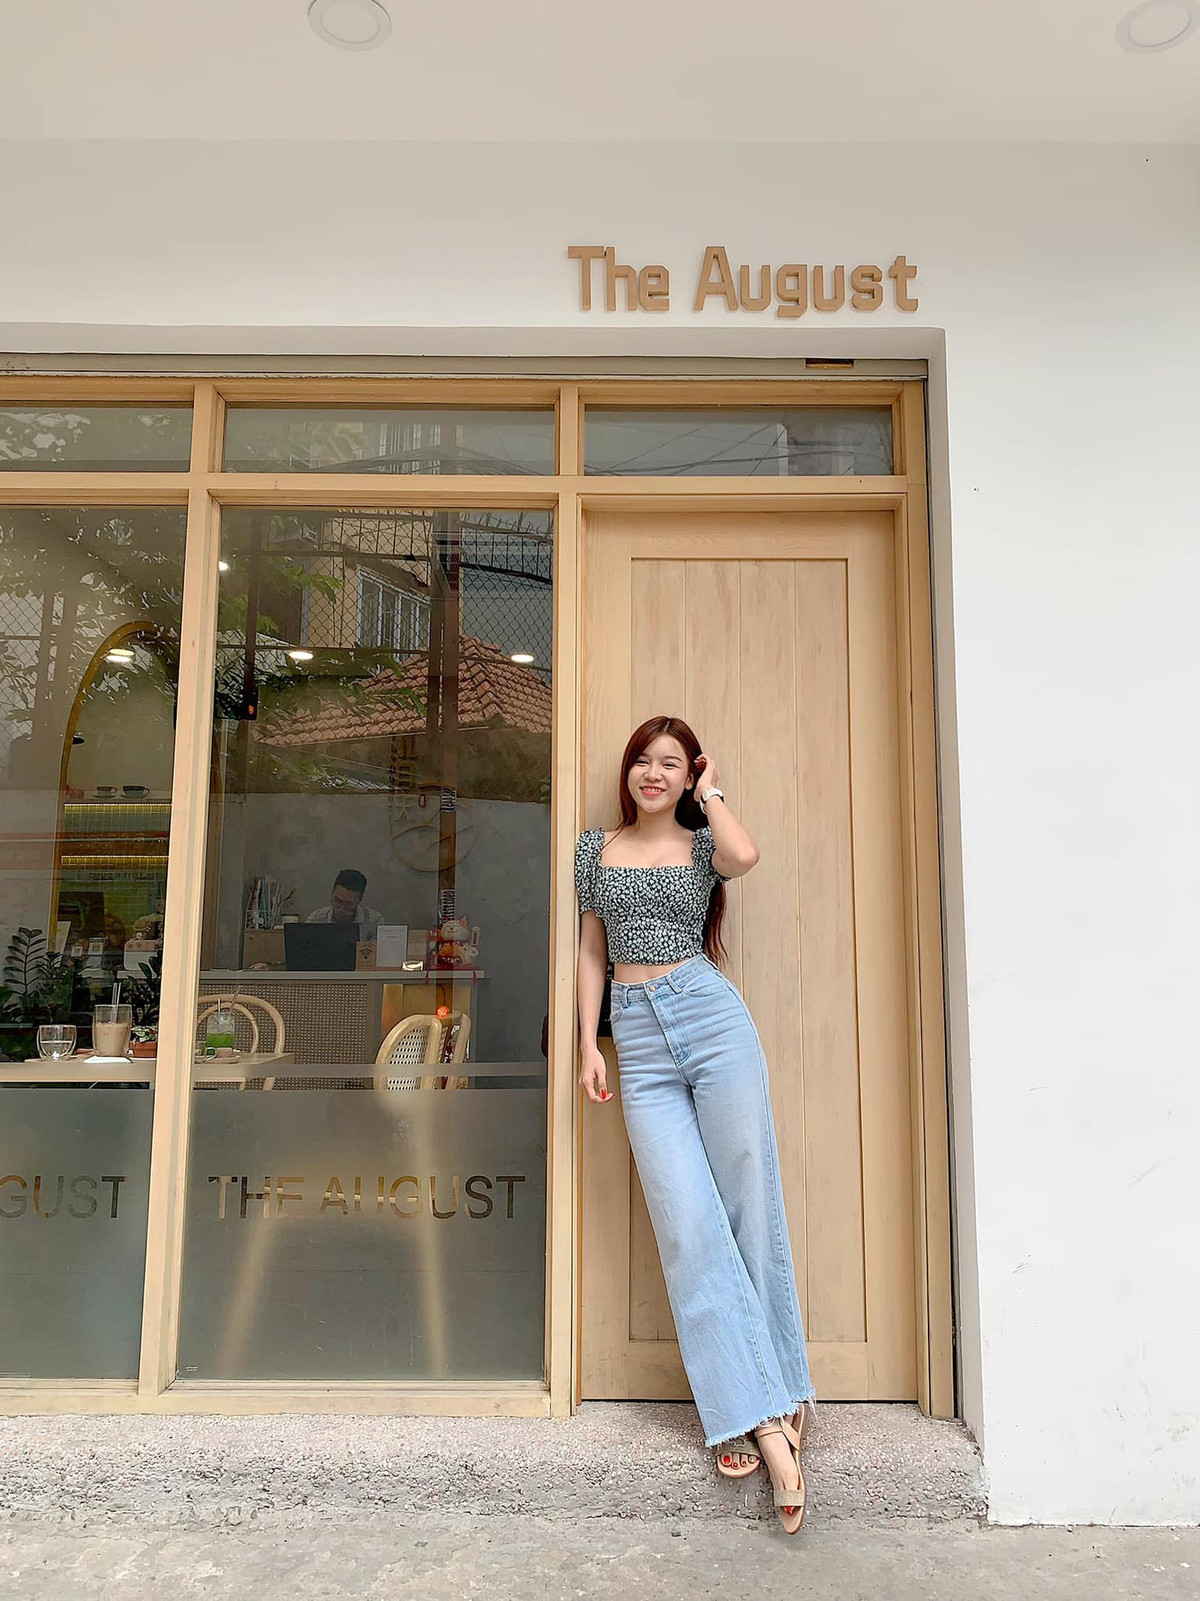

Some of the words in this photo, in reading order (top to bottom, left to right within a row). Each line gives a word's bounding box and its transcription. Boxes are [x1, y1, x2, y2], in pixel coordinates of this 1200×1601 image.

[567, 245, 670, 312] The
[693, 245, 919, 318] August
[0, 1174, 128, 1219] GUST
[208, 1175, 305, 1219] THE
[319, 1175, 526, 1219] AUGUST
